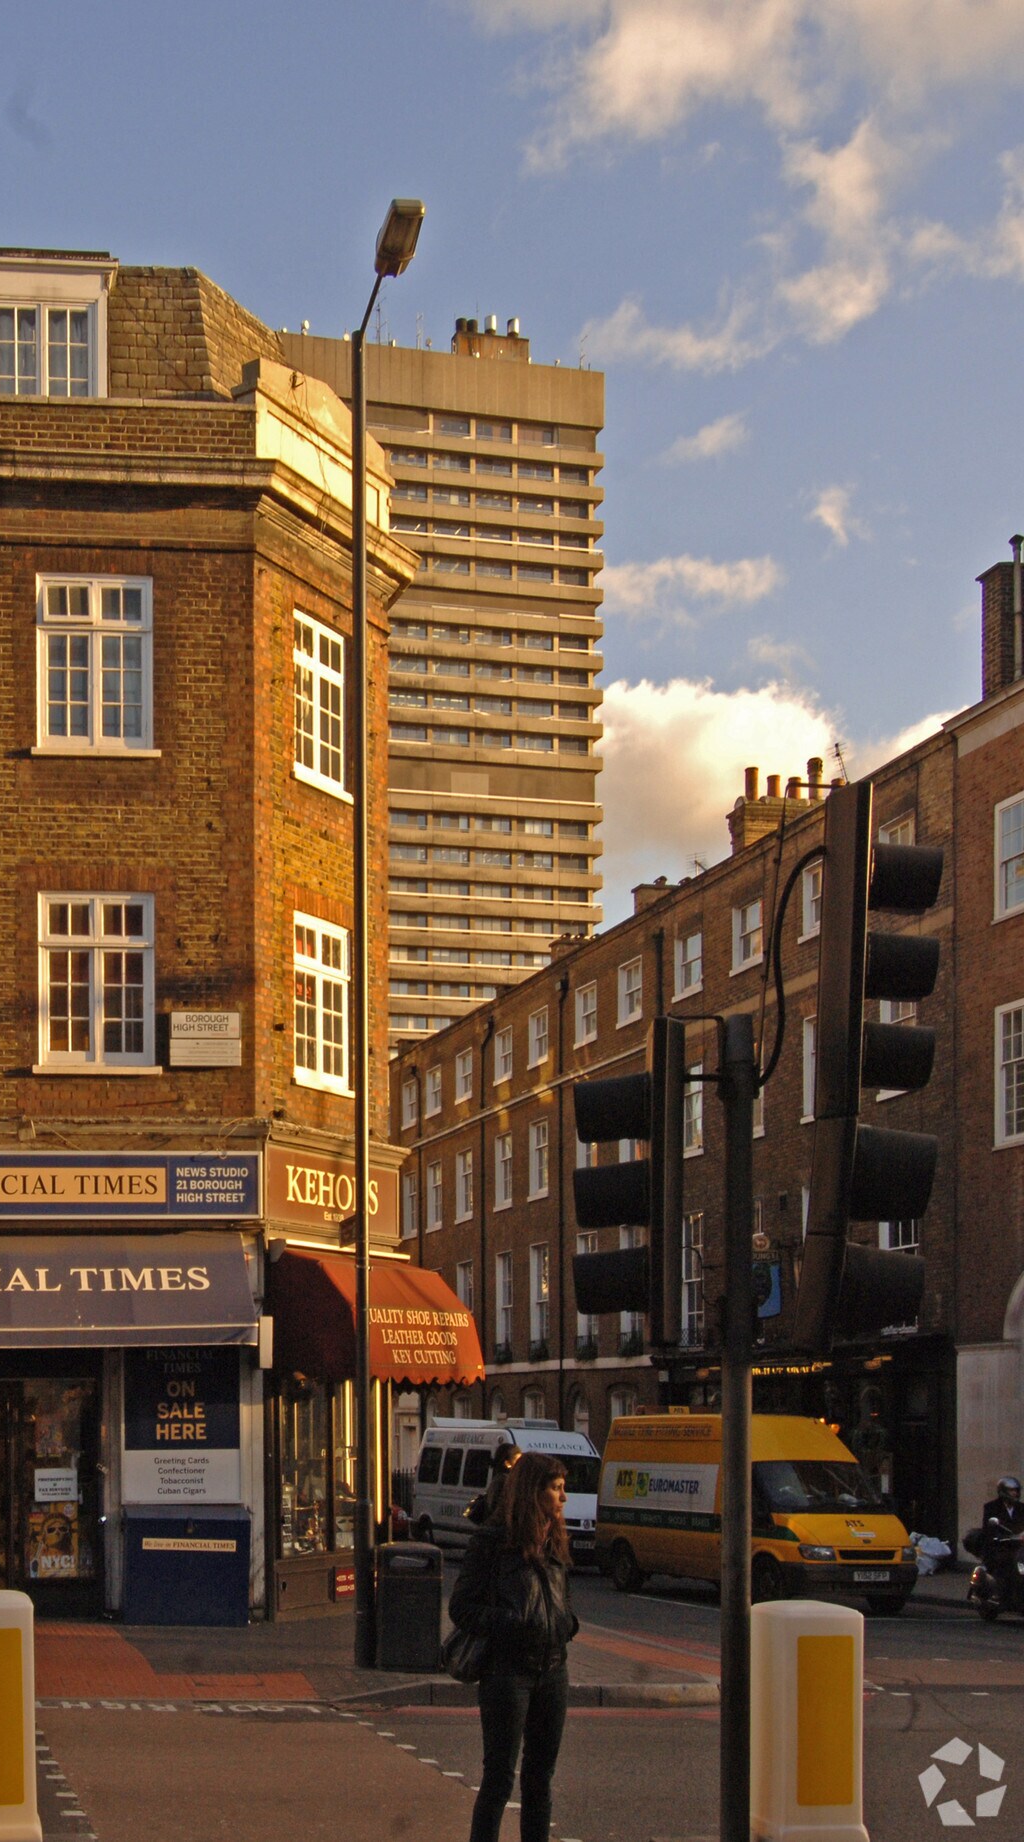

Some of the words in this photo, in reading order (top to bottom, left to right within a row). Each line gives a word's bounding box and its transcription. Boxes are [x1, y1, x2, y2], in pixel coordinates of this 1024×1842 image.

[185, 1014, 229, 1023] BOROUGH
[173, 1023, 196, 1032] HIGH
[197, 1023, 229, 1032] STREET
[176, 1167, 207, 1178] NEWS
[209, 1167, 249, 1178] STUDIO
[74, 1174, 158, 1195] TIMES
[176, 1180, 188, 1190] 21
[190, 1180, 243, 1190] BOROUGH
[286, 1165, 379, 1215] KEHOS
[176, 1192, 203, 1203] HIGH
[205, 1192, 245, 1203] STREET
[70, 1267, 211, 1292] TIMES
[369, 1308, 404, 1324] UALITY
[406, 1310, 432, 1326] SHOE
[432, 1312, 469, 1327] REPAIRS
[382, 1329, 426, 1345] LEATHER
[426, 1331, 458, 1346] GOODS
[392, 1349, 412, 1364] KEY
[413, 1350, 456, 1365] CUTTING
[167, 1381, 195, 1397] ON
[157, 1402, 206, 1419] SALE
[156, 1423, 207, 1440] HERE
[526, 1442, 584, 1452] AMBULANCE
[154, 1457, 186, 1465] Greeting
[617, 1470, 634, 1487] ATS
[648, 1478, 700, 1495] EUROMASTER
[183, 1487, 207, 1495] Cigars
[173, 1541, 212, 1549] FINANCIAL
